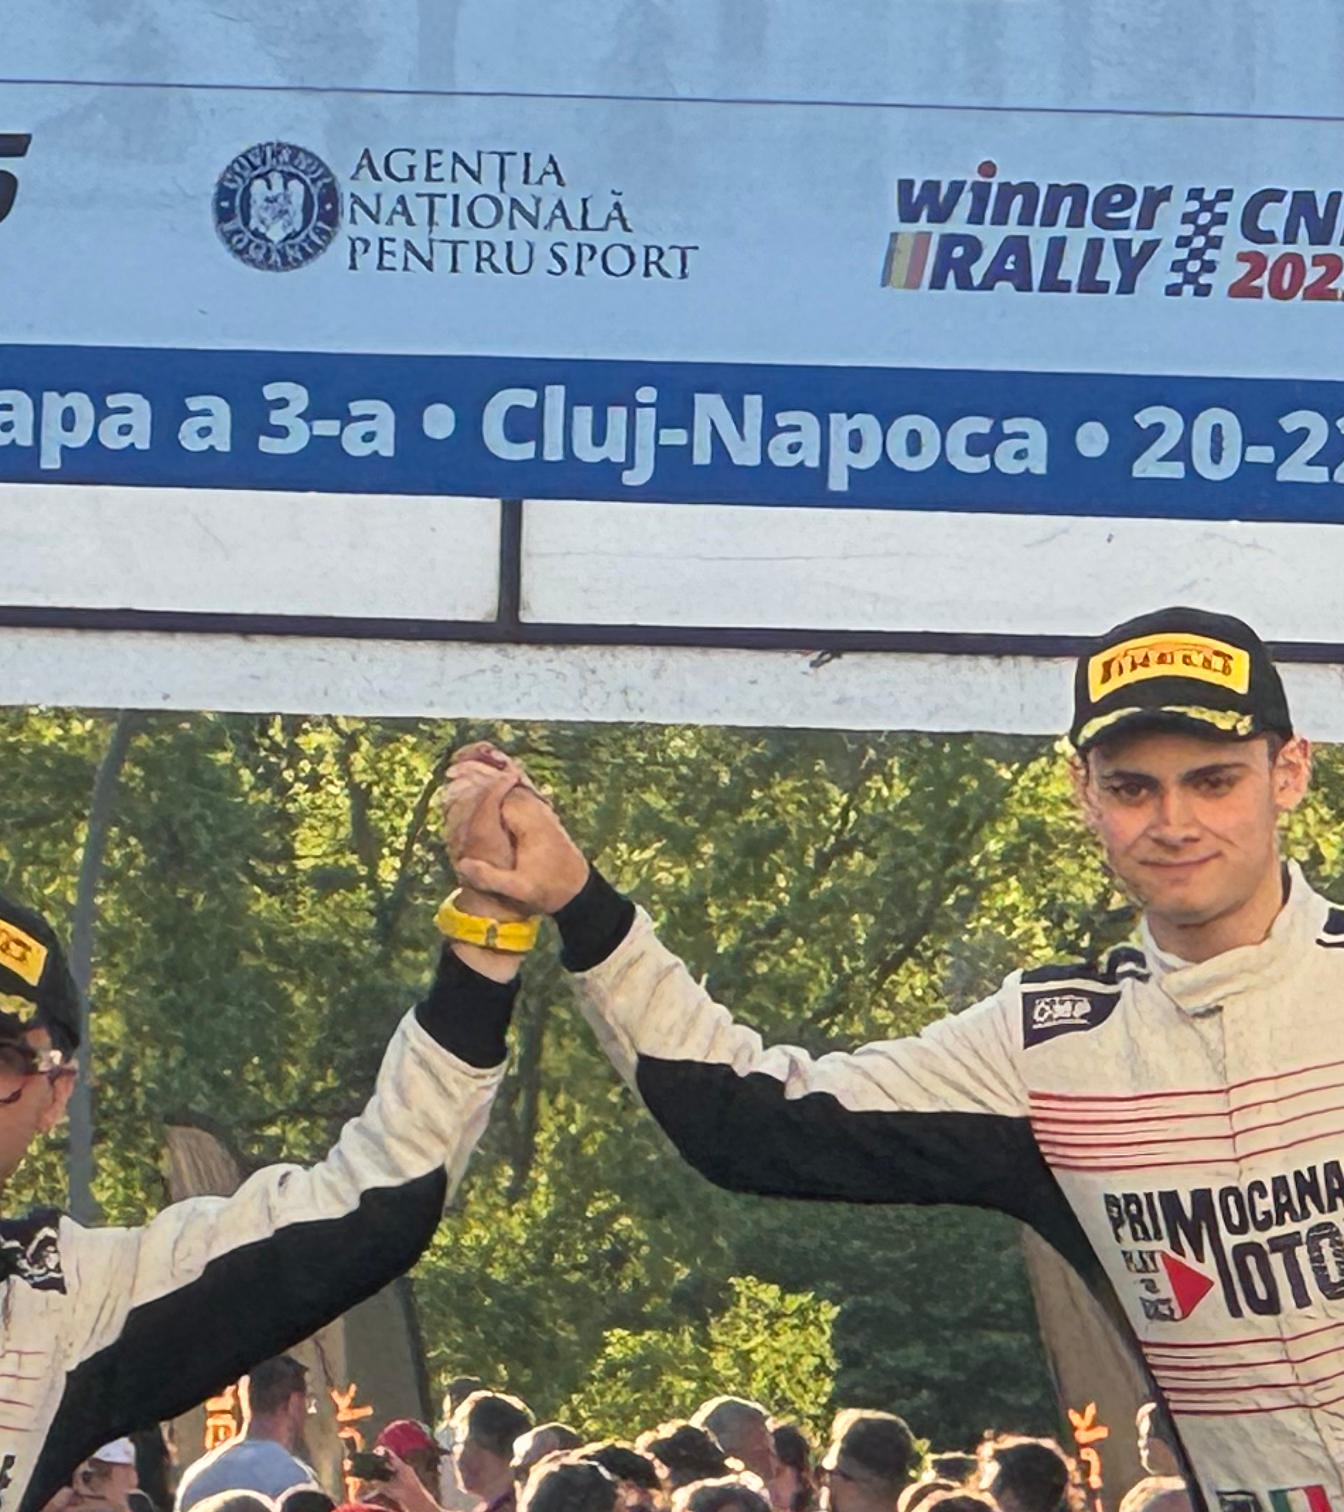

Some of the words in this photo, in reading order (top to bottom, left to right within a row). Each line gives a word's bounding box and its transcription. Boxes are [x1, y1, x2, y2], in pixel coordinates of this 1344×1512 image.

[896, 160, 1174, 230] winner
[347, 235, 535, 276] PENTRU
[546, 241, 700, 280] SPORT
[928, 231, 1163, 296] RALLY
[177, 393, 233, 453] a
[257, 380, 397, 459] 3-a
[481, 383, 1049, 492] Cluj-Napoca
